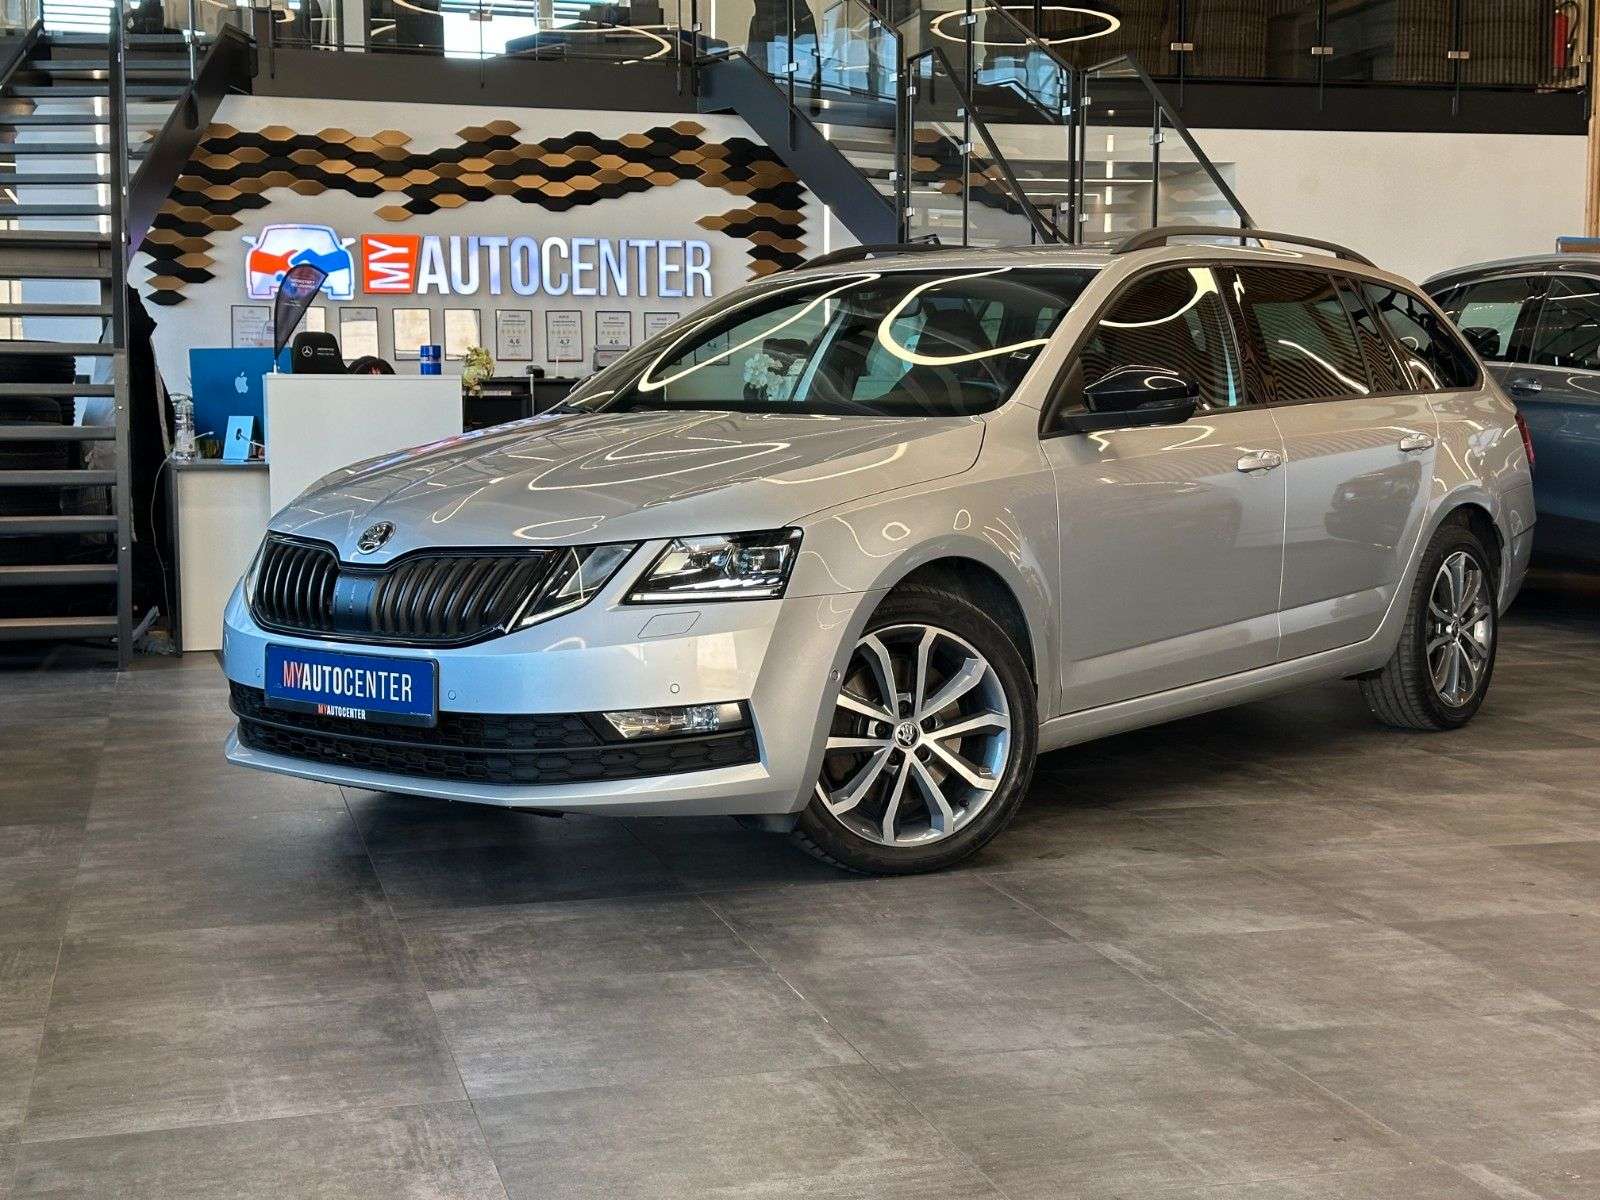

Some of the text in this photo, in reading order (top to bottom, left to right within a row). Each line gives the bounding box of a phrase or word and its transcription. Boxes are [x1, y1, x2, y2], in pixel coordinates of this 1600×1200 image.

[367, 235, 712, 297] MY AUTOCENTER
[283, 660, 412, 702] MYAUTOCENTER
[318, 703, 366, 720] MYAUTOCENTER
